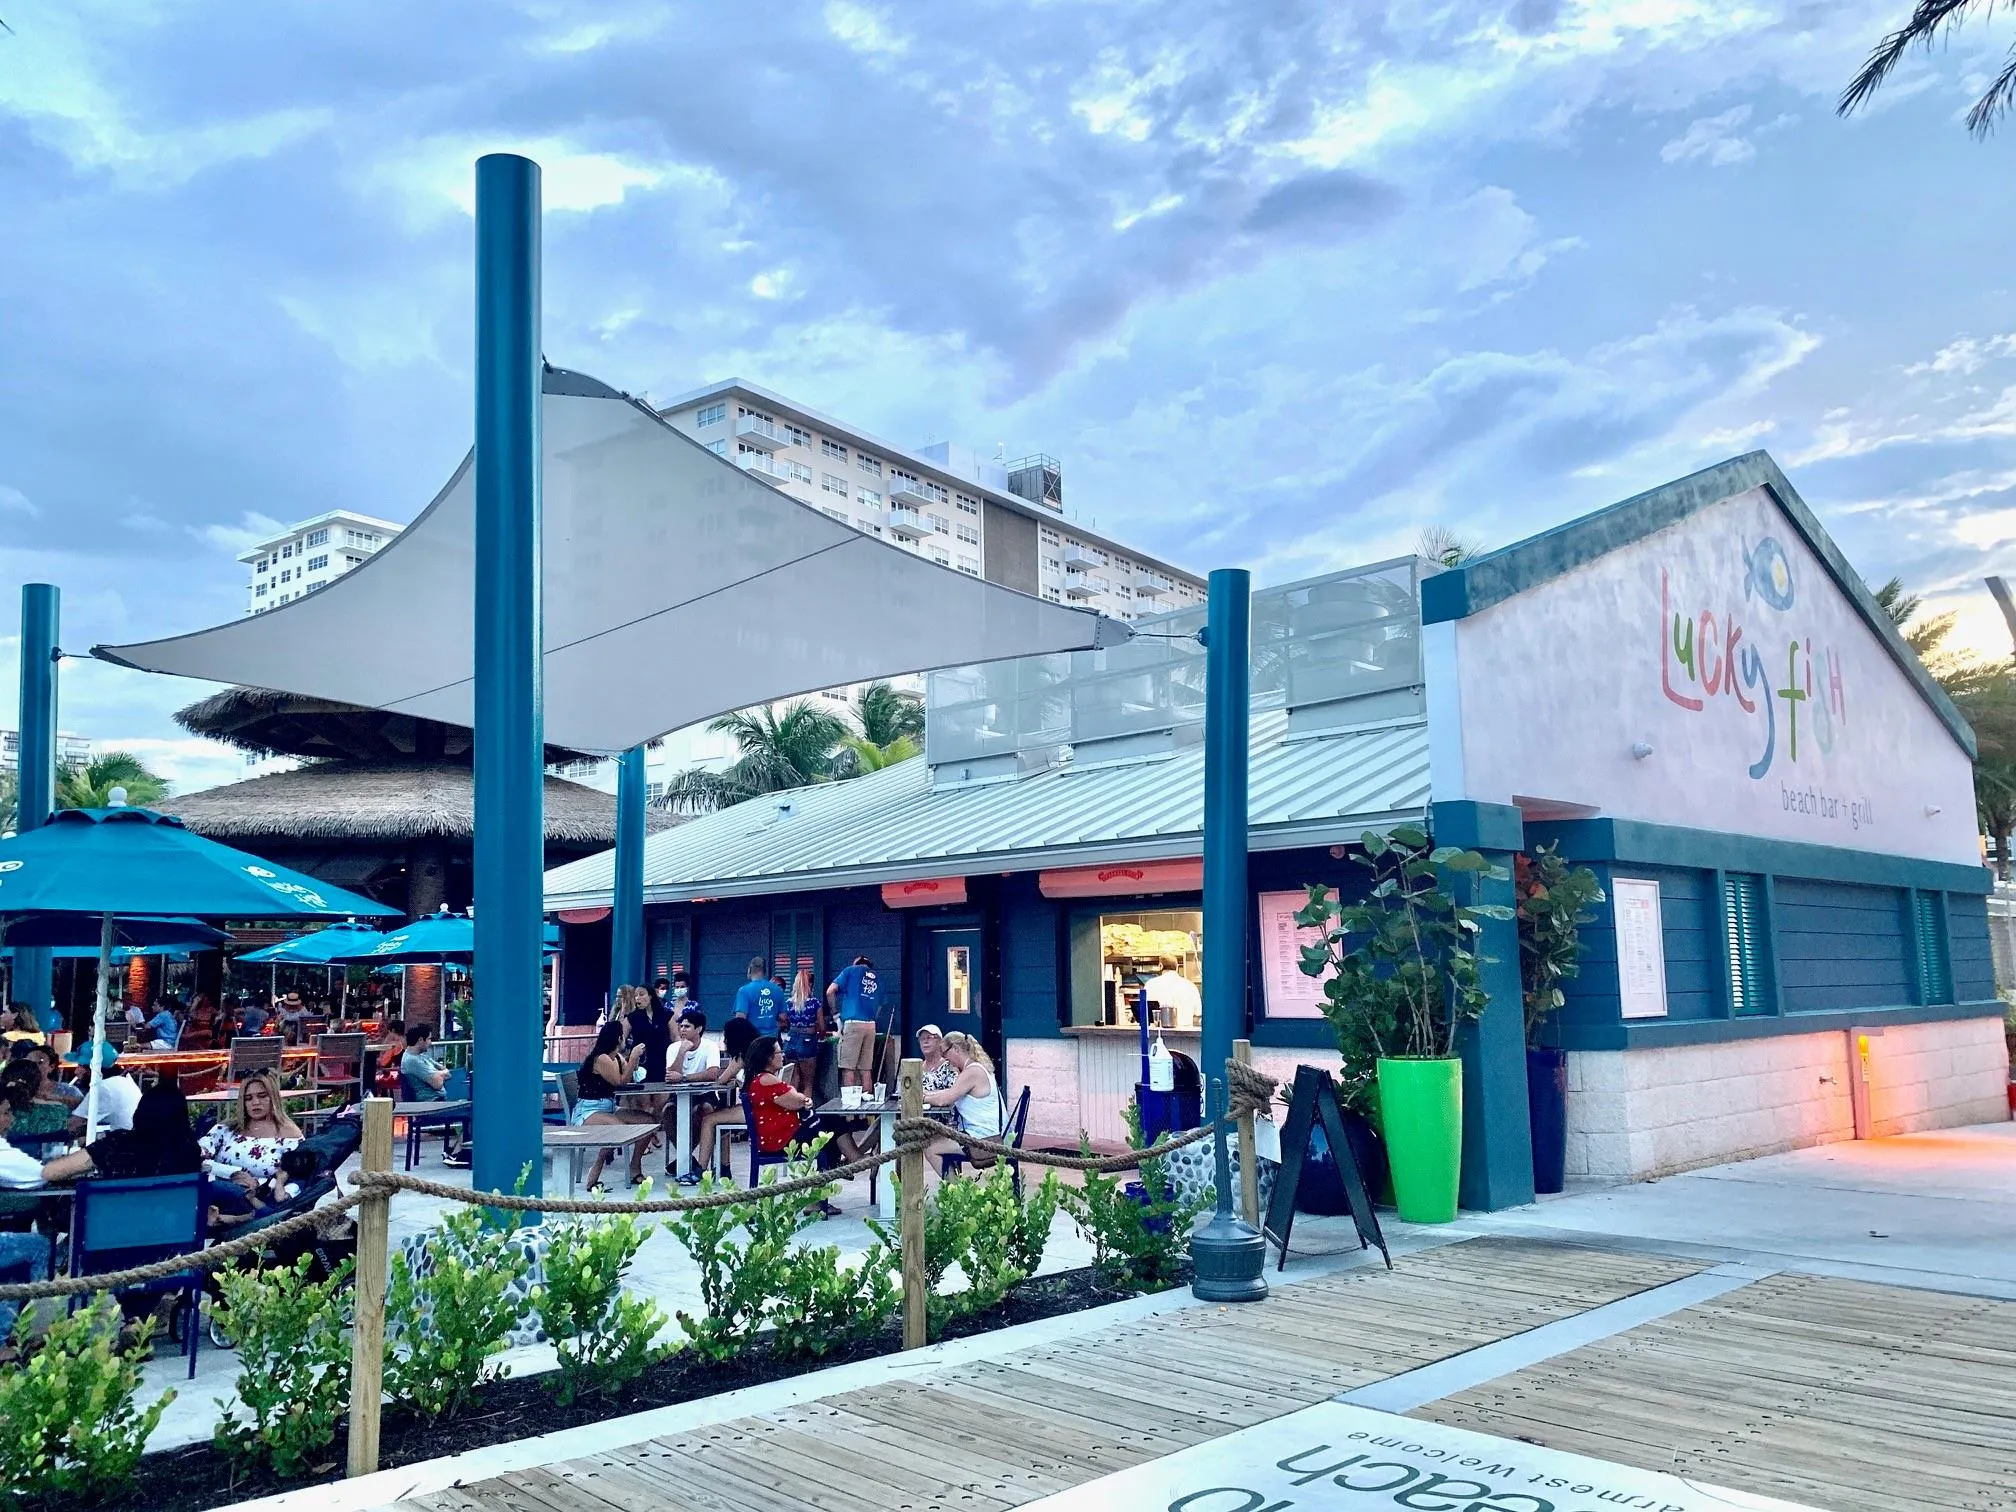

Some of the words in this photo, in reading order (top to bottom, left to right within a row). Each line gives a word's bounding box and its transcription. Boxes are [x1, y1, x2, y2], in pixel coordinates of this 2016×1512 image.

[1780, 779, 1818, 815] beach
[1819, 787, 1838, 819] bar
[1850, 795, 1873, 830] grill
[315, 1247, 334, 1273] BRAV
[1275, 1444, 1596, 1512] each
[1347, 1431, 1516, 1478] Welcome
